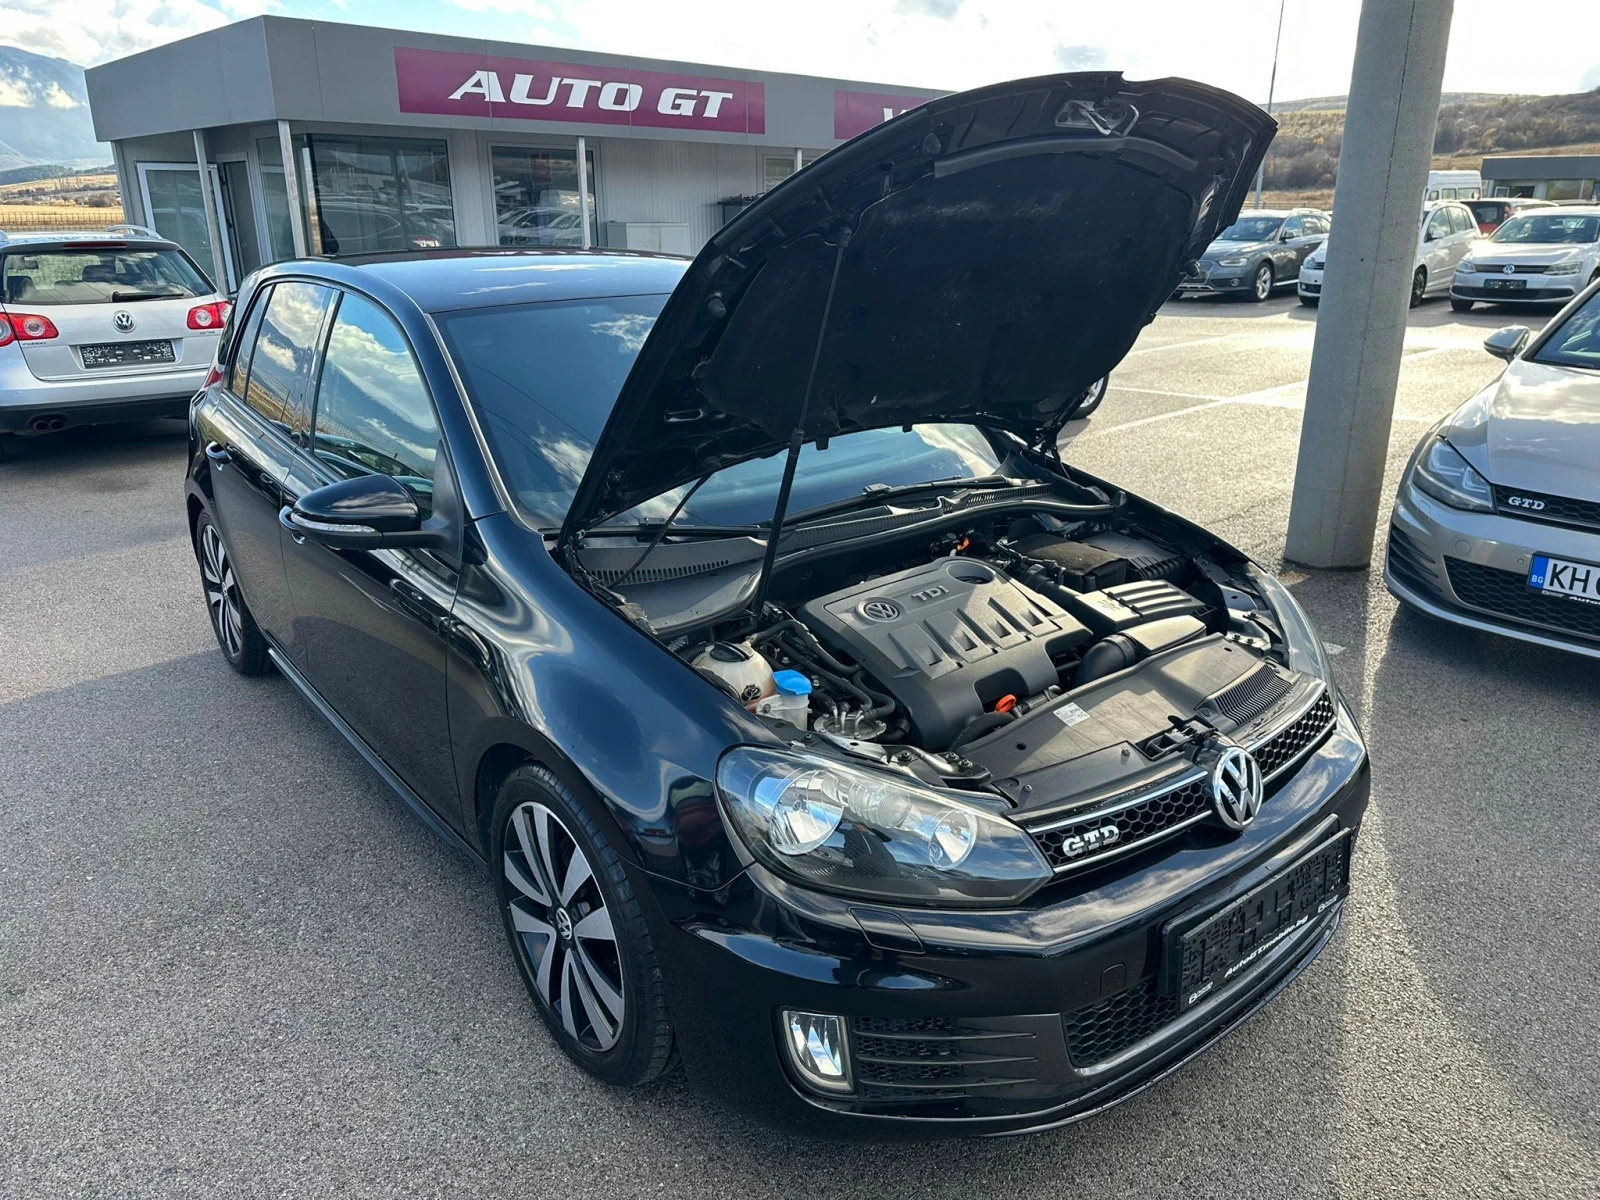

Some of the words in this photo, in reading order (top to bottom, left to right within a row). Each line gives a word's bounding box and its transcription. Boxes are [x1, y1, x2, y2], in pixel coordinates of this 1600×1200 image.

[448, 70, 643, 112] AUTO
[657, 87, 733, 118] GT
[1509, 497, 1544, 510] GTD
[1531, 574, 1544, 584] BG
[911, 585, 949, 601] TDI
[1062, 825, 1119, 857] GTD
